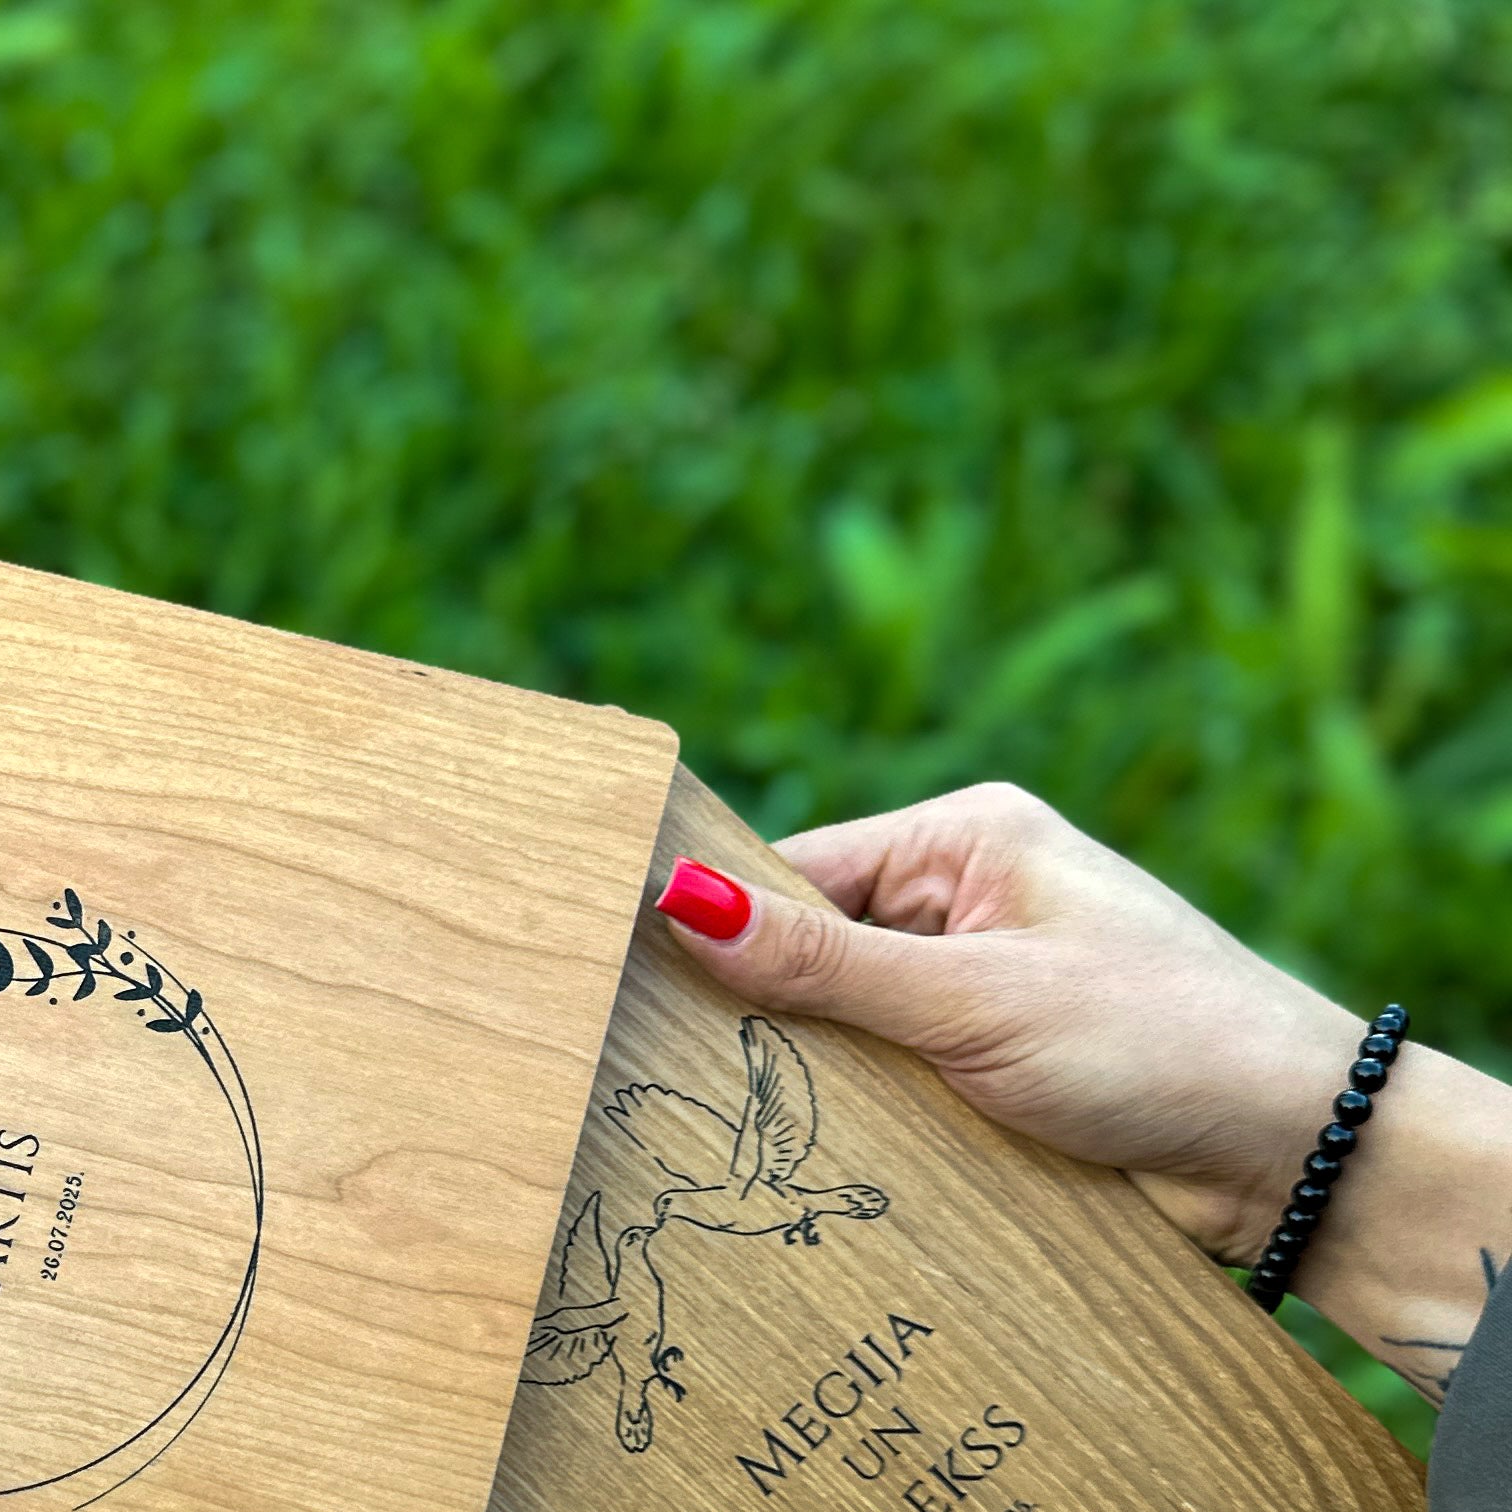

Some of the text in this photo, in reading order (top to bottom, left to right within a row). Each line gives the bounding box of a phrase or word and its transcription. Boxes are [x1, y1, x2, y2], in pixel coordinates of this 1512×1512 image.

[40, 1172, 85, 1281] 26.07.2025.
[734, 1313, 934, 1498] MEGIJA
[841, 1406, 922, 1481] UN
